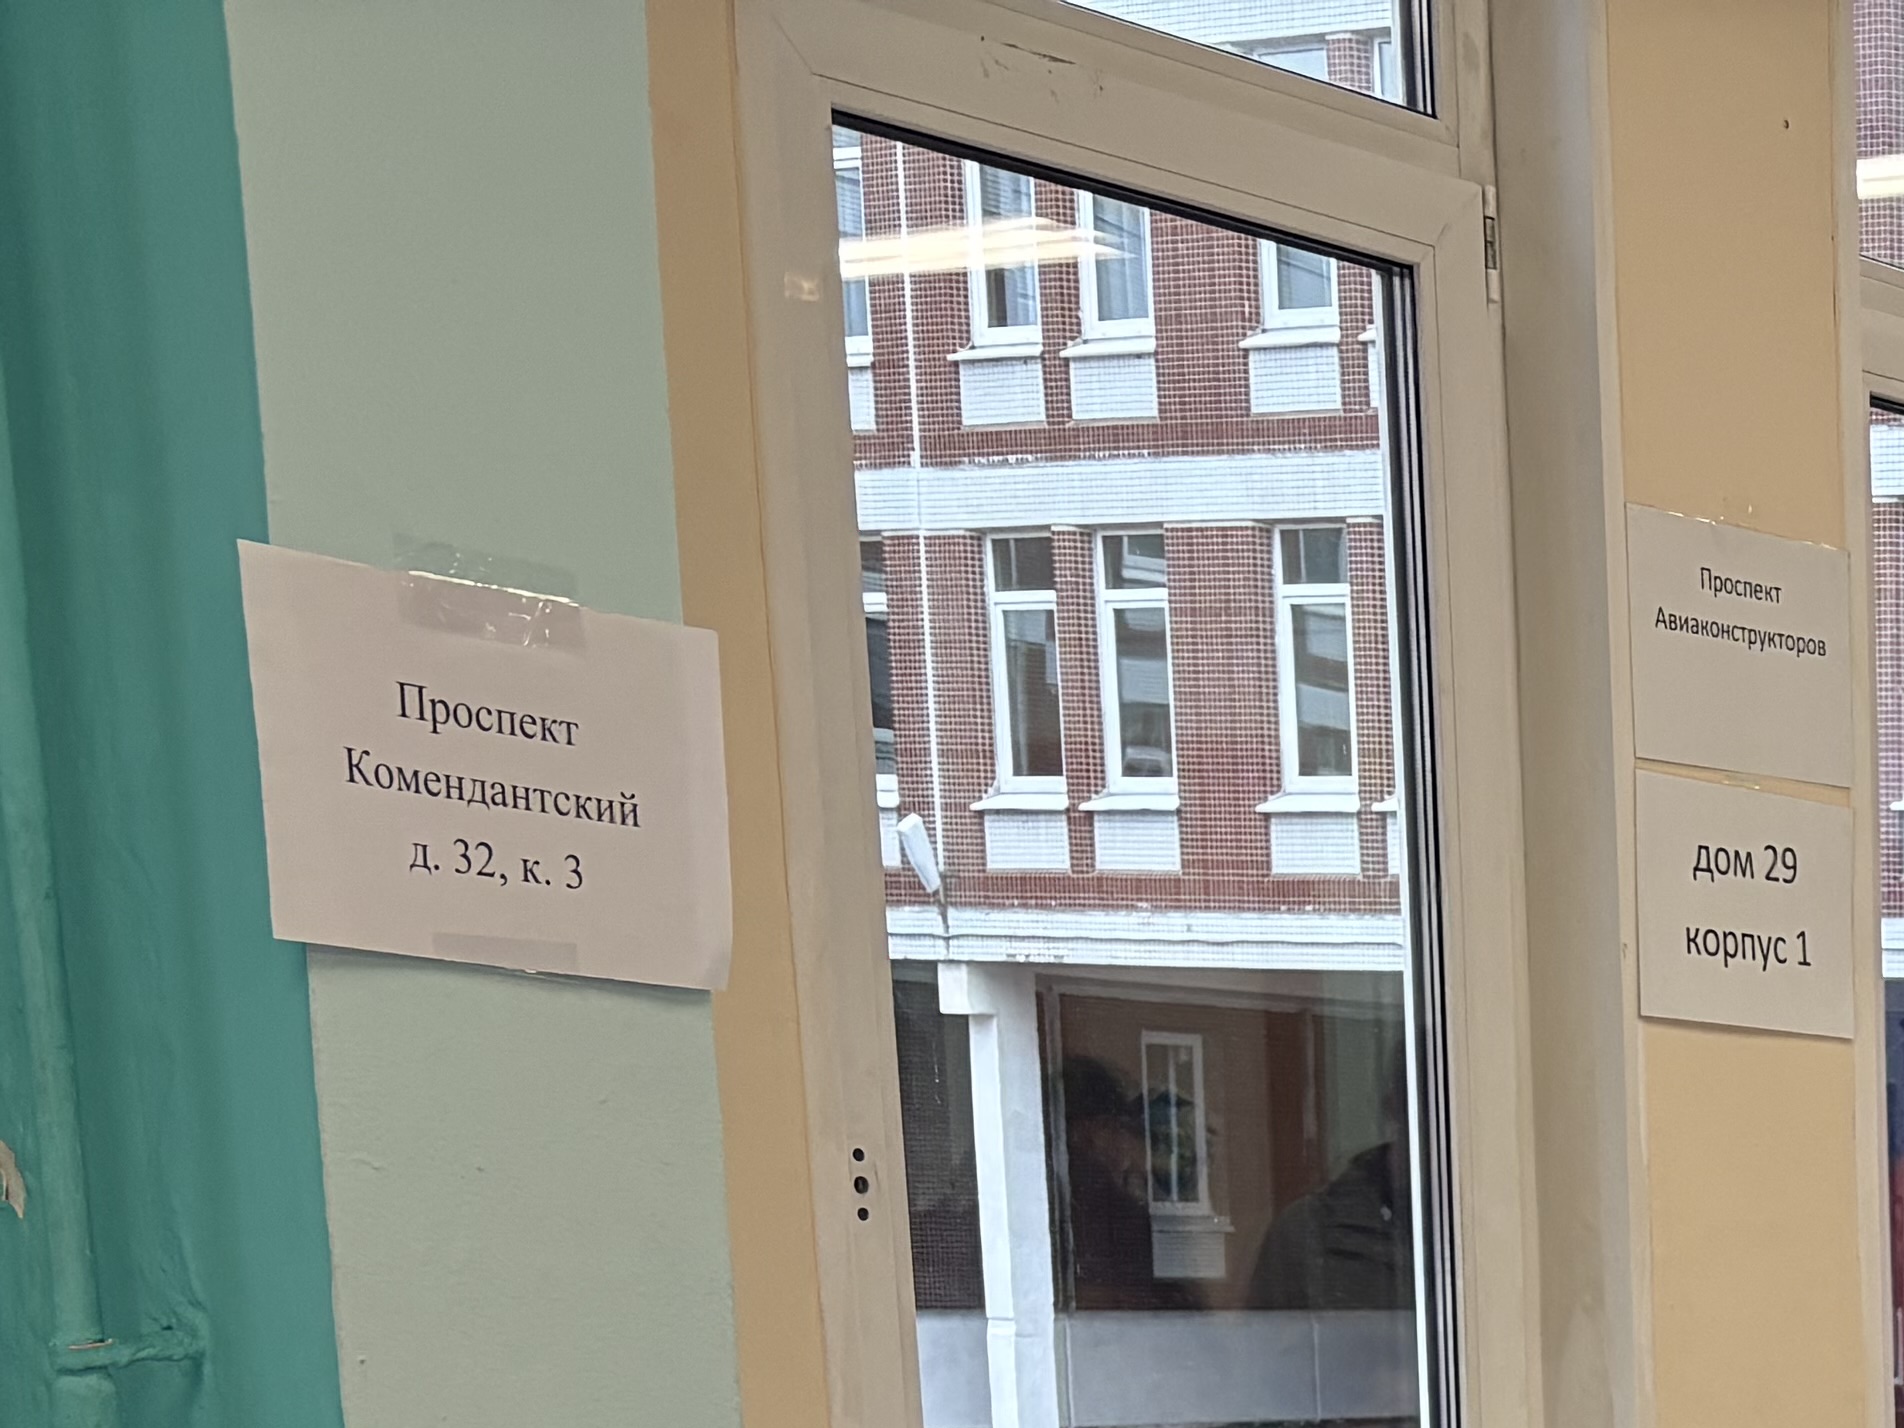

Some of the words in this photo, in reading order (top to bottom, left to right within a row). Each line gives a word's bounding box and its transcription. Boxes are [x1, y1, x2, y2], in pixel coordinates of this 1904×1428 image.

[1699, 567, 1783, 604] Проспект
[1654, 606, 1827, 657] Авиаконструкторов
[394, 680, 580, 746] Проспект
[342, 746, 642, 827] Комендантский
[409, 842, 441, 874] д.
[452, 838, 509, 886] 32,
[520, 857, 552, 886] к.
[564, 855, 584, 889] 3
[1692, 844, 1755, 882] дом
[1763, 844, 1798, 884] 29
[1685, 926, 1788, 972] корпус
[1796, 930, 1812, 967] 1
